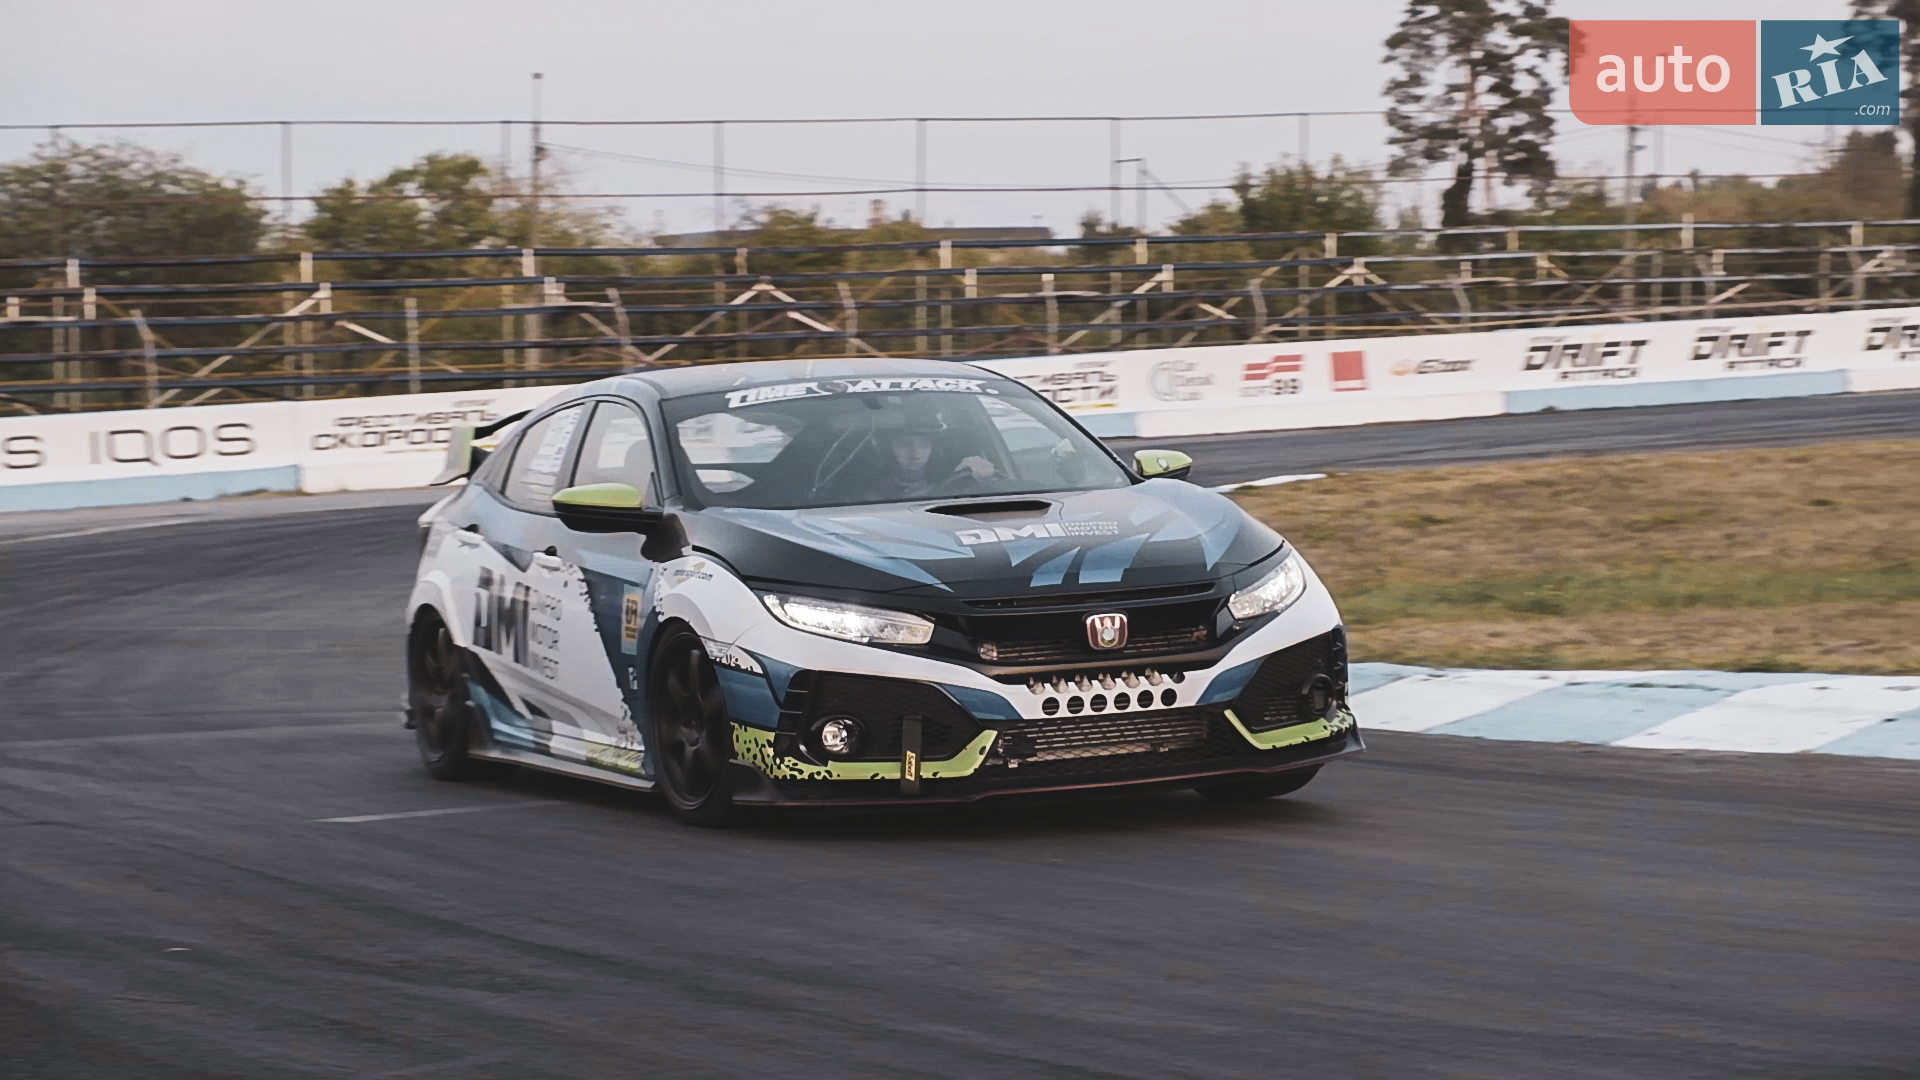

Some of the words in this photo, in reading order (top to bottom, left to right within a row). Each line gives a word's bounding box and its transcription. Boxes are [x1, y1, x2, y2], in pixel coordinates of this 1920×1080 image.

[725, 382, 820, 408] TIME
[845, 378, 987, 394] ATTACK
[89, 422, 257, 467] IQOS
